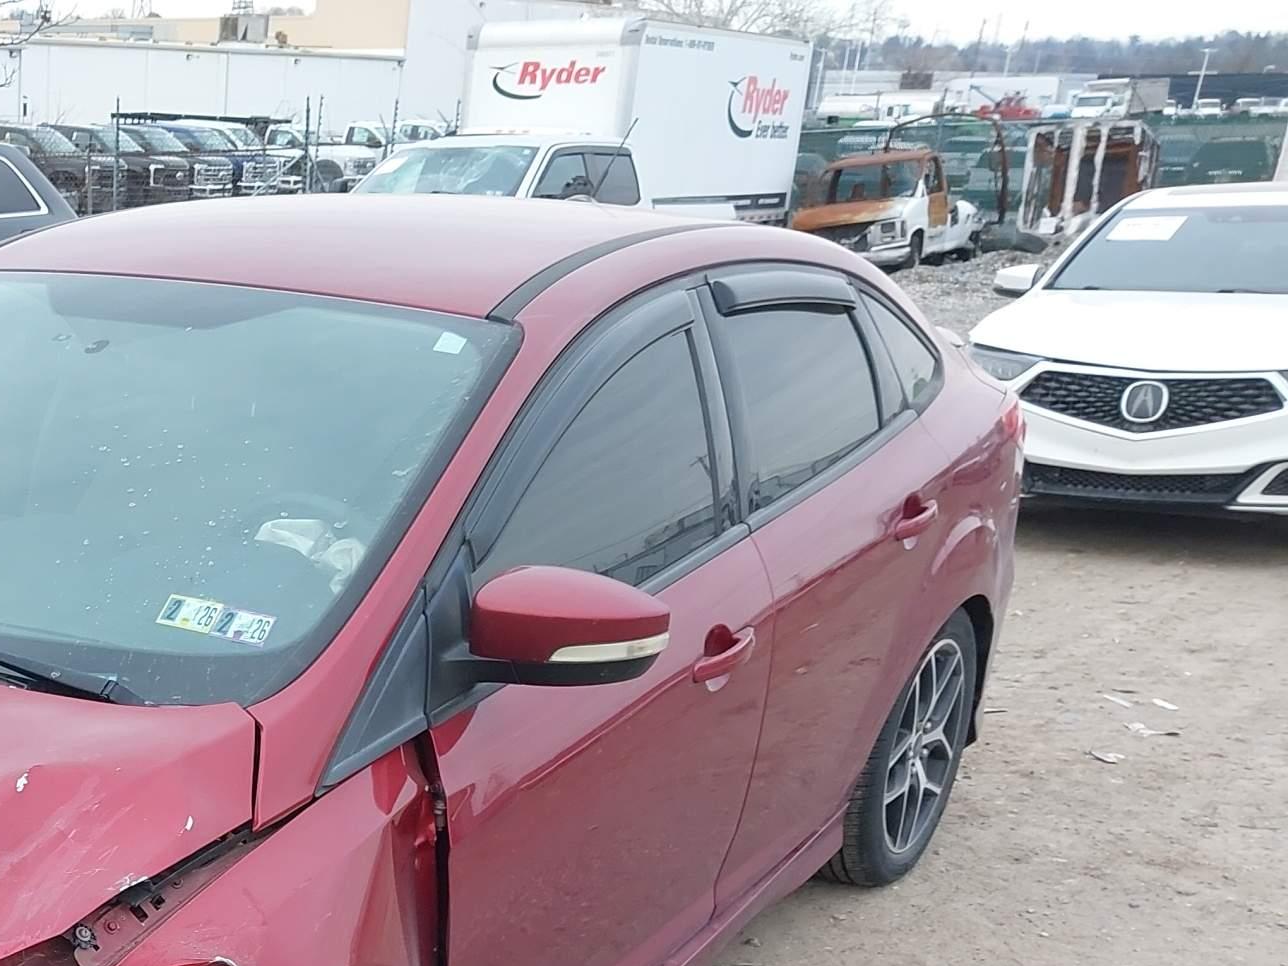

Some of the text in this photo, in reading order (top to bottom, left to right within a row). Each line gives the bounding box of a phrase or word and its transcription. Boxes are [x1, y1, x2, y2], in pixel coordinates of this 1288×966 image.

[517, 59, 606, 91] Ryder
[742, 75, 789, 124] Ryder
[166, 599, 218, 627] 2 26
[217, 611, 271, 641] 2 26
